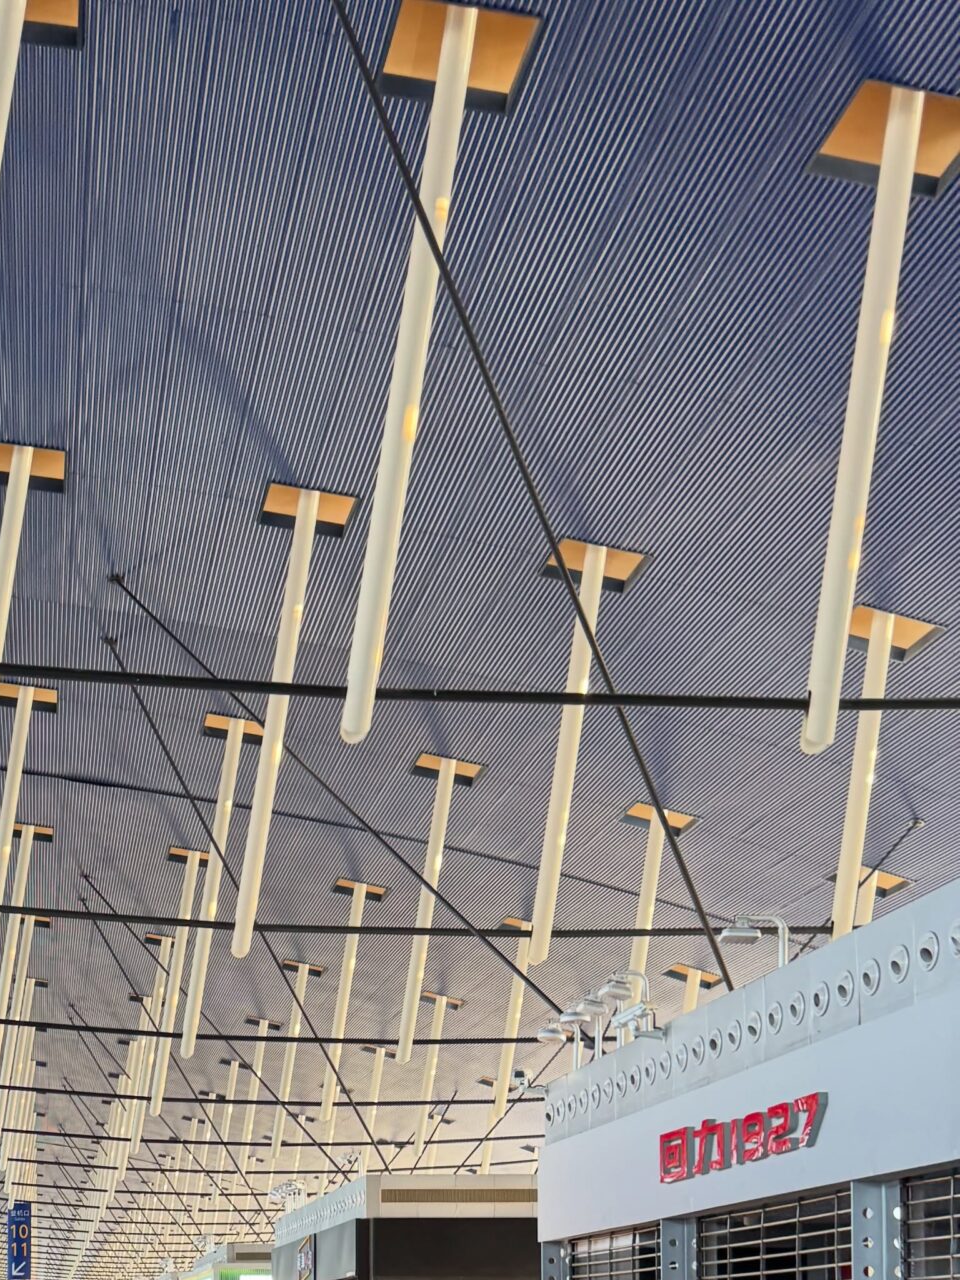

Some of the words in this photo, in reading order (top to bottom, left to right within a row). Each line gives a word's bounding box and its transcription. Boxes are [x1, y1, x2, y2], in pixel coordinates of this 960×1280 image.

[659, 1091, 828, 1185] 回力1927
[10, 1224, 29, 1239] 10
[11, 1242, 28, 1257] 11
